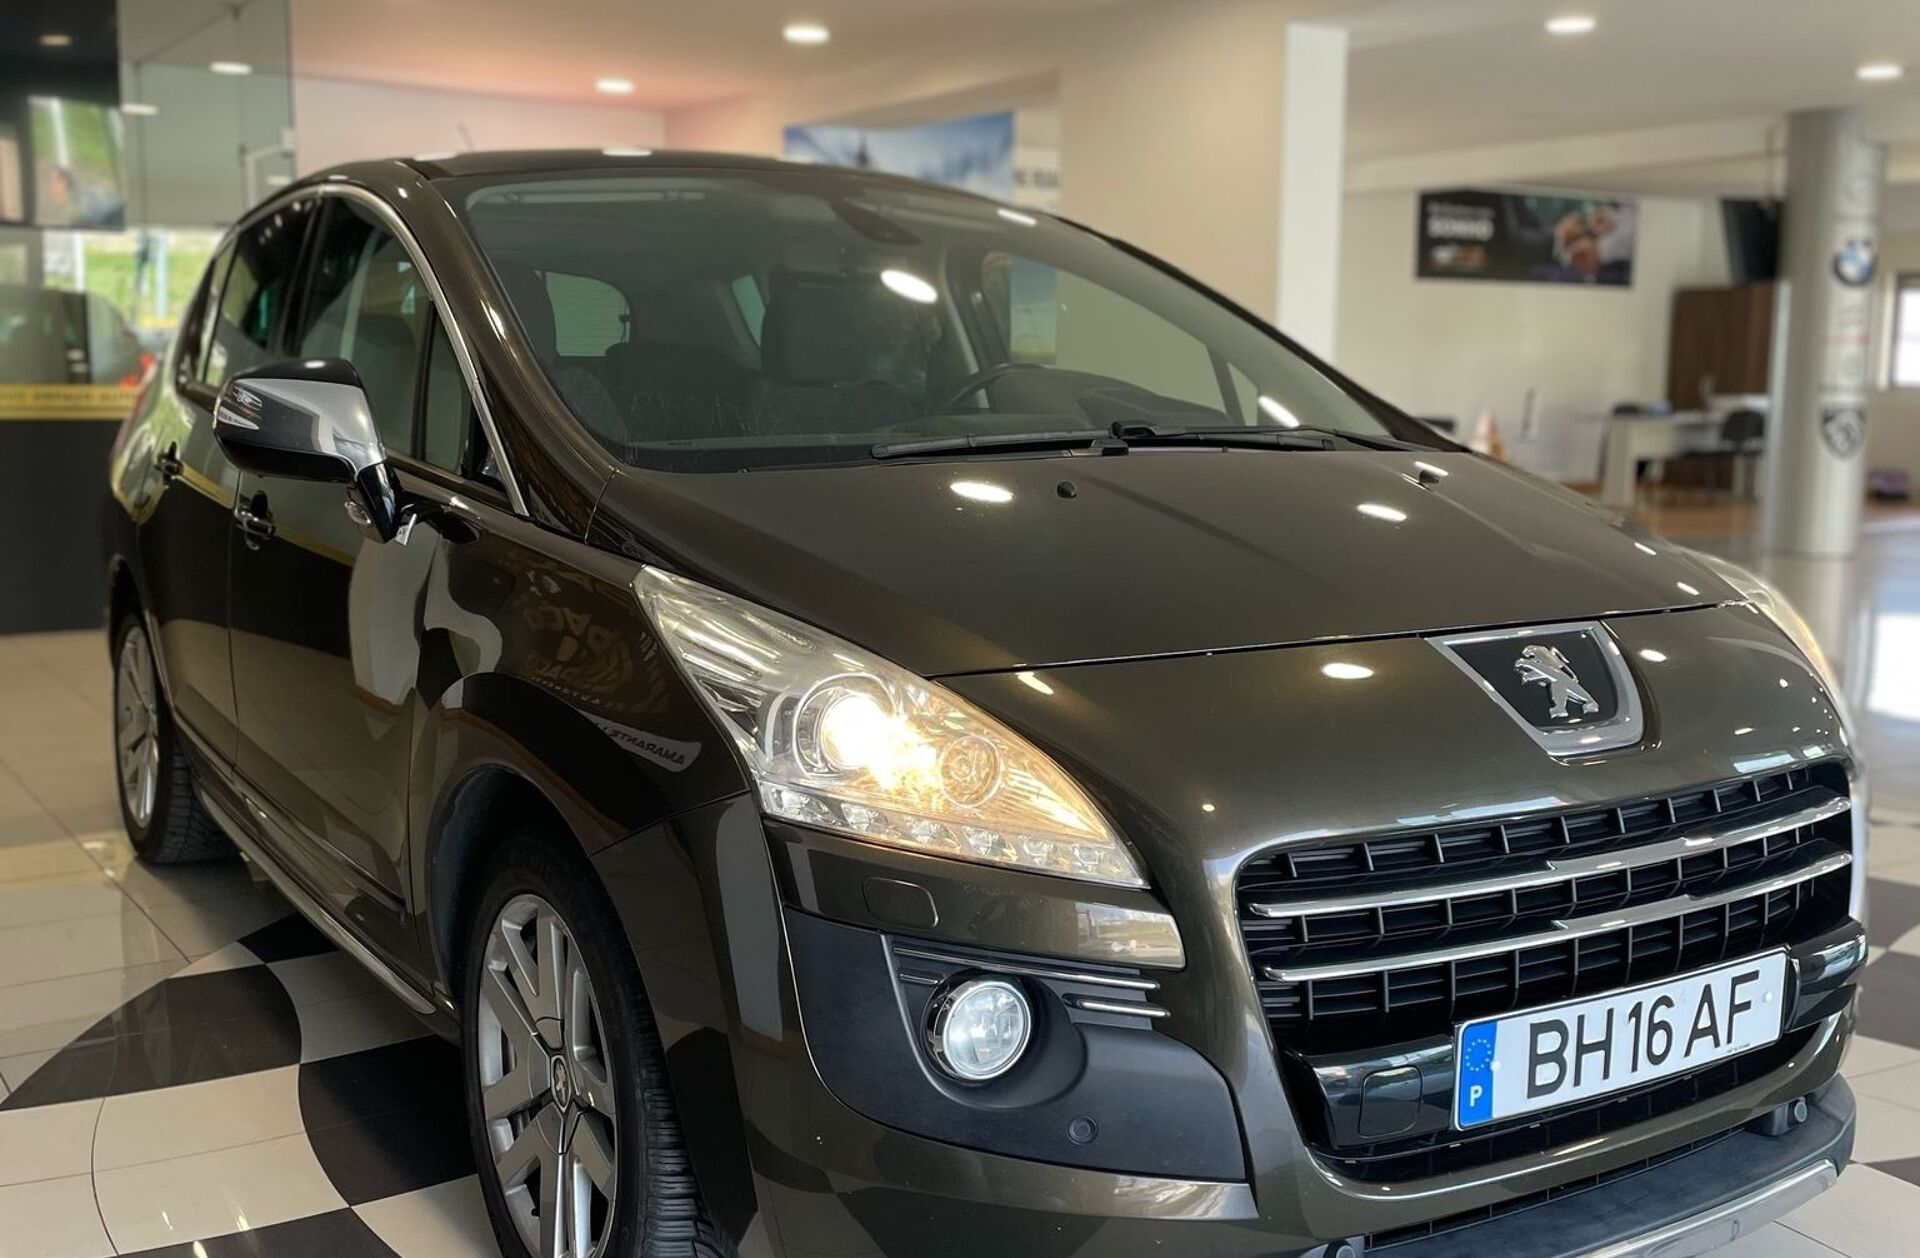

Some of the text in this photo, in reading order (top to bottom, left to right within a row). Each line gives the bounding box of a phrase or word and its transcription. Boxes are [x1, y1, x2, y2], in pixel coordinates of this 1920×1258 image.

[1527, 969, 1760, 1099] BH 16 AF
[1470, 1085, 1483, 1107] P
